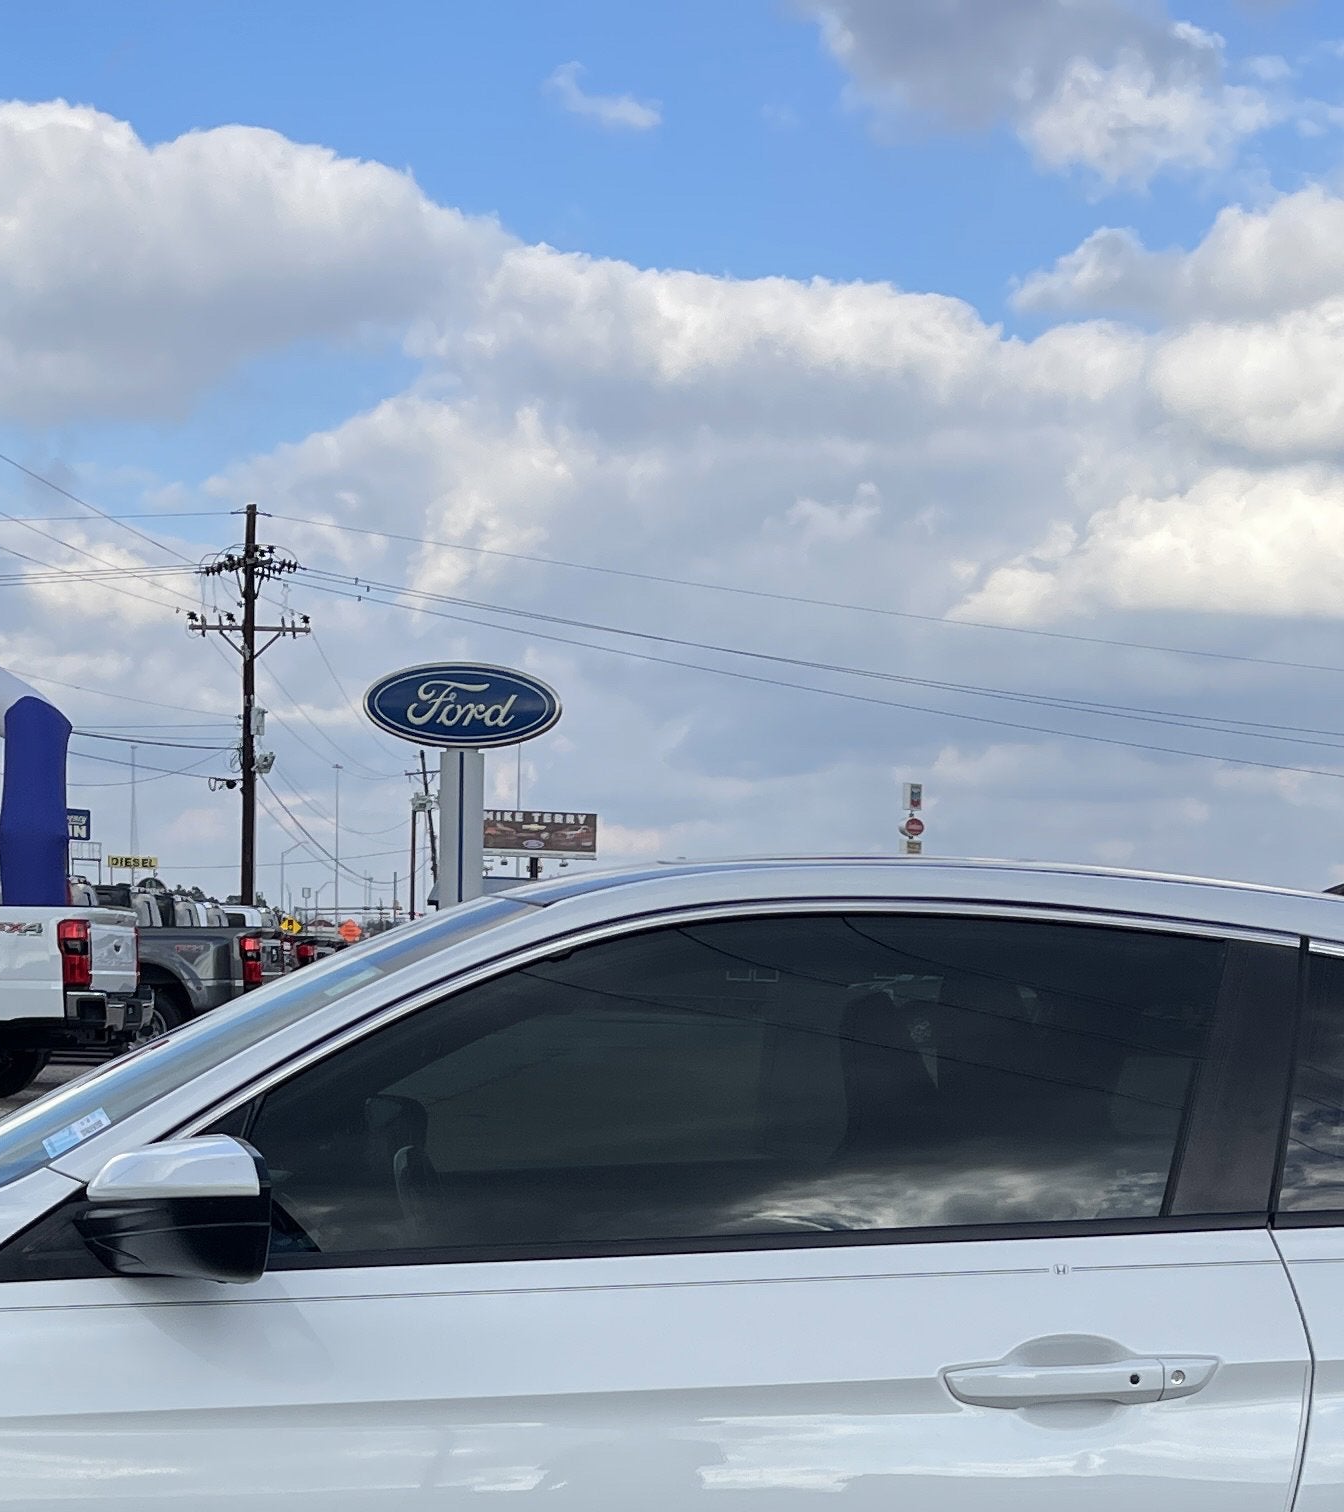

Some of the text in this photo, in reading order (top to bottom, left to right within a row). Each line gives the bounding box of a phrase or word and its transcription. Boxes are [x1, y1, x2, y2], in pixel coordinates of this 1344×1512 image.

[407, 679, 518, 727] Ford
[483, 811, 586, 825] MIKE TERRY
[110, 857, 156, 868] DIESEL
